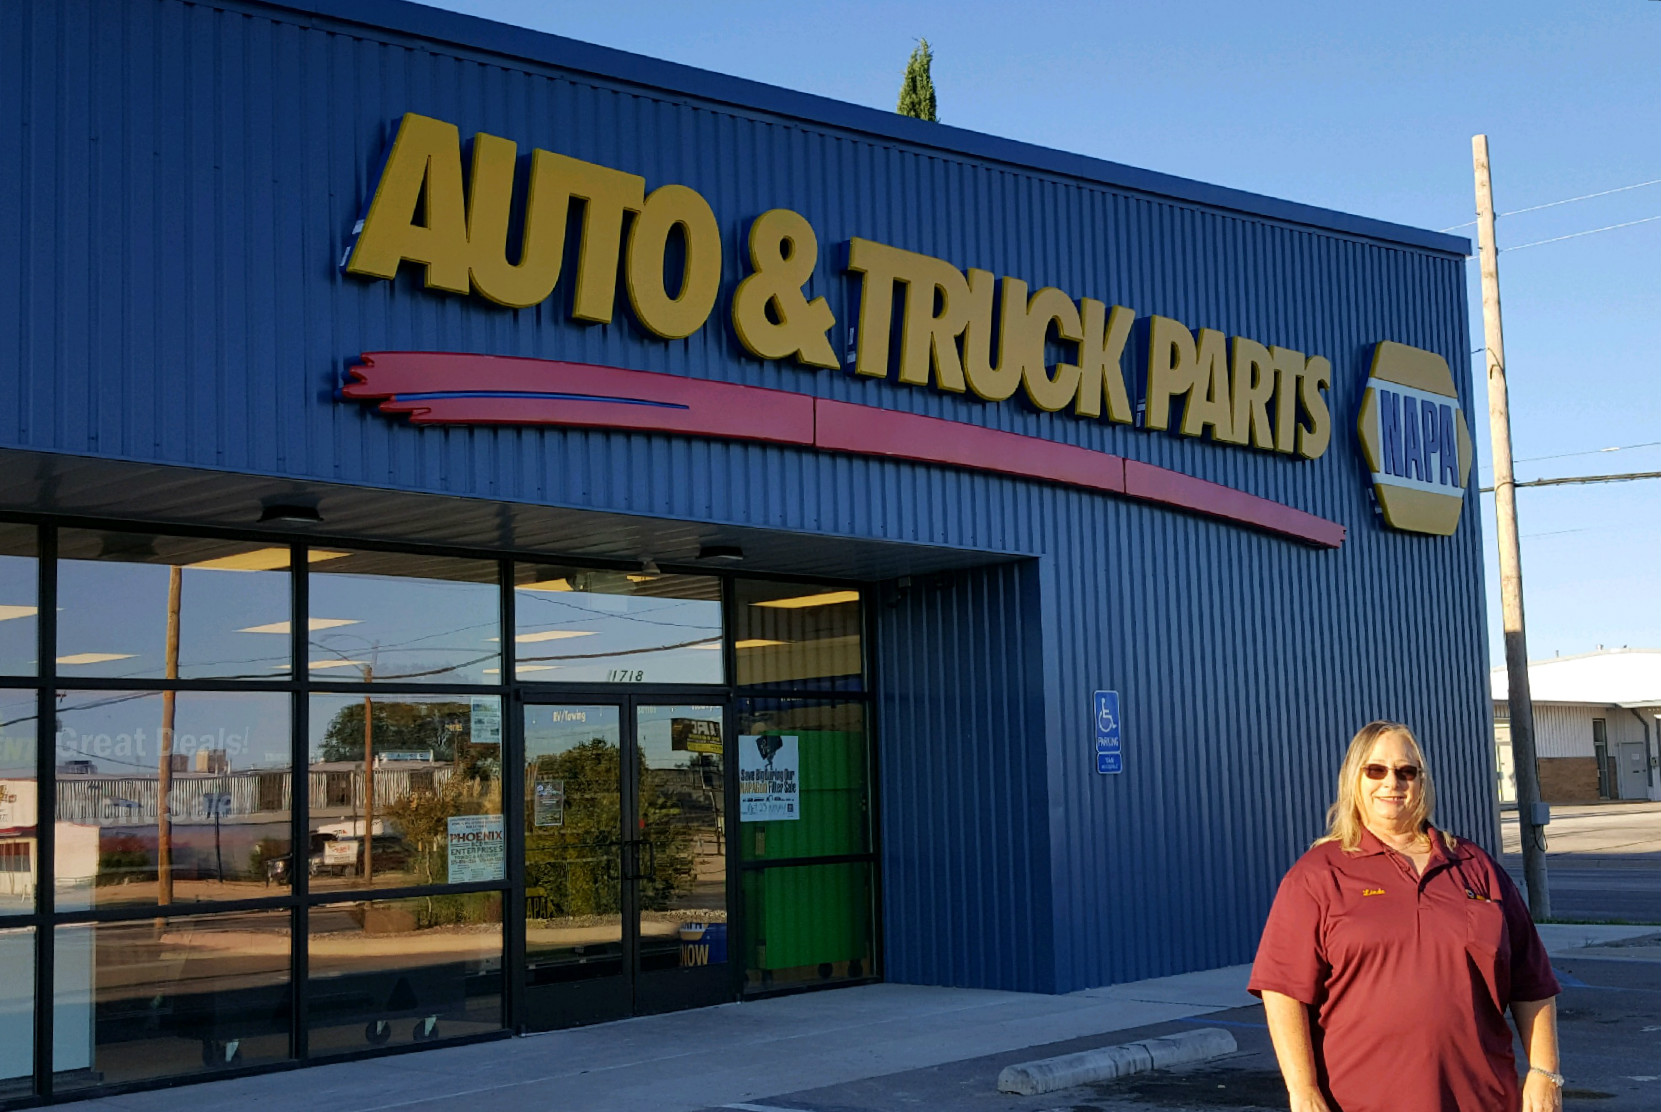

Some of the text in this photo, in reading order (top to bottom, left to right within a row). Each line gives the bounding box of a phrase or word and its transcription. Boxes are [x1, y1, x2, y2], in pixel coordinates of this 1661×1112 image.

[346, 112, 1332, 461] AUTO & TRUCK PARTS
[1380, 389, 1459, 488] NAPA
[612, 670, 644, 682] 1718
[1097, 736, 1119, 747] PARKING
[741, 769, 754, 781] Save
[785, 768, 794, 780] Our
[769, 781, 783, 793] Filter
[785, 781, 796, 793] Sale
[449, 831, 503, 843] PHOENIX
[450, 845, 504, 856] ENTERPRISES
